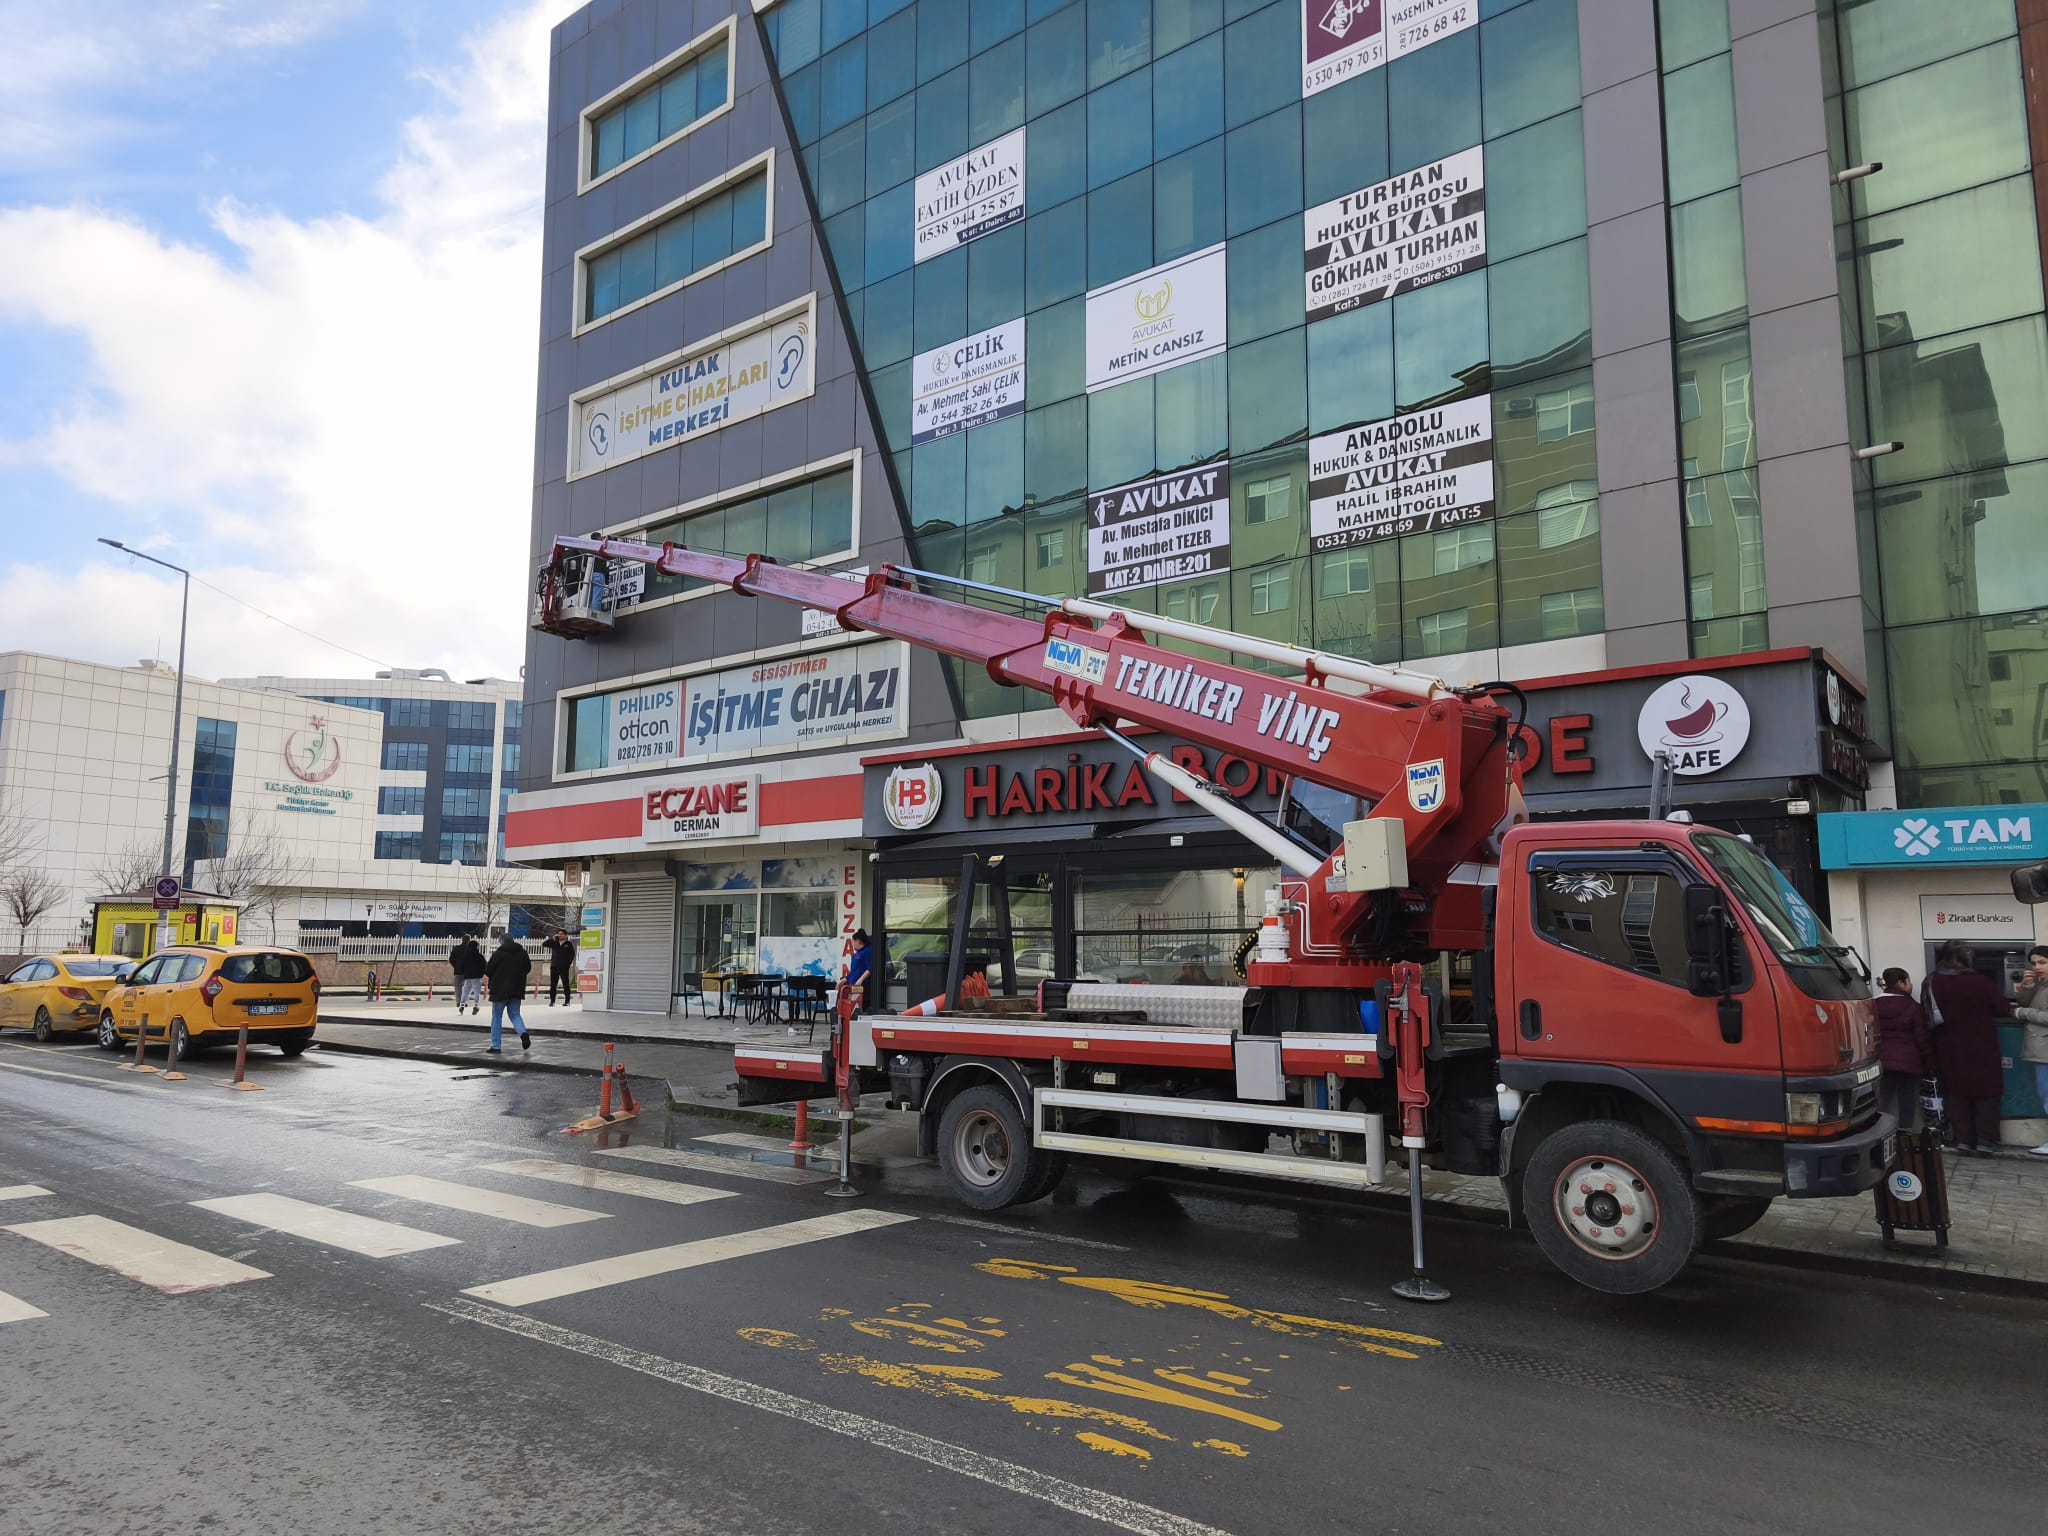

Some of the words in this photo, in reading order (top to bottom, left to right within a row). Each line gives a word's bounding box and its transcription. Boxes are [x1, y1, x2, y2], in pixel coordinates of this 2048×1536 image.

[1409, 24, 1429, 44] 726
[1434, 16, 1447, 32] 68
[1453, 8, 1466, 23] 42
[1306, 76, 1312, 89] 0
[1316, 67, 1332, 85] 530
[1336, 58, 1353, 75] 479
[1358, 52, 1369, 68] 70
[1373, 46, 1383, 61] 51
[937, 148, 998, 190] AVUKAT
[918, 190, 959, 222] FATİH
[964, 163, 1018, 200] ÖZDEN
[1340, 163, 1443, 215] TURHAN
[920, 222, 948, 243] 0538
[953, 209, 975, 229] 944
[981, 200, 995, 217] 25
[1000, 191, 1015, 208] 87
[1318, 210, 1379, 243] HUKUK
[1388, 177, 1468, 218] BÜROSU
[1328, 198, 1458, 264] AVUKAT
[1470, 244, 1480, 253] 28
[1312, 252, 1388, 293] GÖKHAN
[1395, 221, 1478, 265] TURHAN
[1334, 297, 1360, 312] Kat:3
[1413, 263, 1463, 288] Daire:301
[1132, 318, 1173, 340] AVUKAT
[954, 335, 1004, 368] ÇELİK
[1109, 348, 1148, 371] METİN
[1153, 330, 1204, 356] CANSIZ
[659, 353, 719, 393] KULAK
[923, 378, 950, 392] HUKUK
[962, 354, 1017, 380] DANIŞMANLIK
[620, 398, 672, 434] İŞİTME
[676, 361, 768, 412] CİHAZLARI
[917, 403, 928, 416] Av.
[932, 389, 969, 411] Mehmet
[994, 370, 1020, 393] ÇELİK
[932, 415, 938, 425] 0
[941, 409, 957, 423] 544
[960, 403, 978, 416] 382
[980, 397, 992, 410] 26
[996, 393, 1007, 404] 45
[649, 397, 729, 446] MERKEZİ
[985, 411, 998, 421] 303
[1346, 411, 1443, 452] ANADOLU
[1313, 453, 1359, 475] HUKUK
[1364, 450, 1374, 463] &
[1379, 424, 1480, 460] DANIŞMANLIK
[1344, 452, 1447, 492] AVUKAT
[1119, 472, 1217, 516] AVUKAT
[1337, 491, 1379, 512] HALİL
[1385, 474, 1457, 501] İBRAHİM
[1339, 493, 1456, 529] MAHMUTOĞLU
[1102, 530, 1118, 544] Av.
[1121, 517, 1170, 540] Mustafa
[1317, 533, 1347, 548] 0532
[1351, 527, 1373, 542] 797
[1377, 523, 1393, 536] 48
[1441, 506, 1481, 524] KAT:5
[1104, 551, 1119, 565] Av.
[1123, 539, 1173, 562] Mehmet
[1176, 529, 1211, 550] TEZER
[629, 581, 637, 593] 25
[1106, 566, 1140, 589] KAT:2
[1144, 553, 1211, 581] DAİRE:201
[620, 691, 673, 715] PHILIPS
[688, 688, 783, 745] İŞİTME
[790, 667, 899, 723] CİHAZI
[1114, 654, 1243, 725] TEKNİKER
[1255, 691, 1341, 762] VİNÇ
[620, 718, 669, 740] oticon
[825, 721, 860, 733] UYGULAMA
[618, 746, 635, 760] 0282
[637, 745, 651, 758] 726
[654, 743, 662, 755] 76
[665, 741, 673, 753] 10
[1670, 749, 1722, 770] CAFE
[647, 781, 747, 820] ECZANE
[964, 753, 1153, 818] HARİKA
[674, 817, 720, 832] DERMAN
[1944, 816, 2032, 844] TAM
[1948, 914, 1975, 923] Ziraat
[1977, 914, 2014, 923] Bankası
